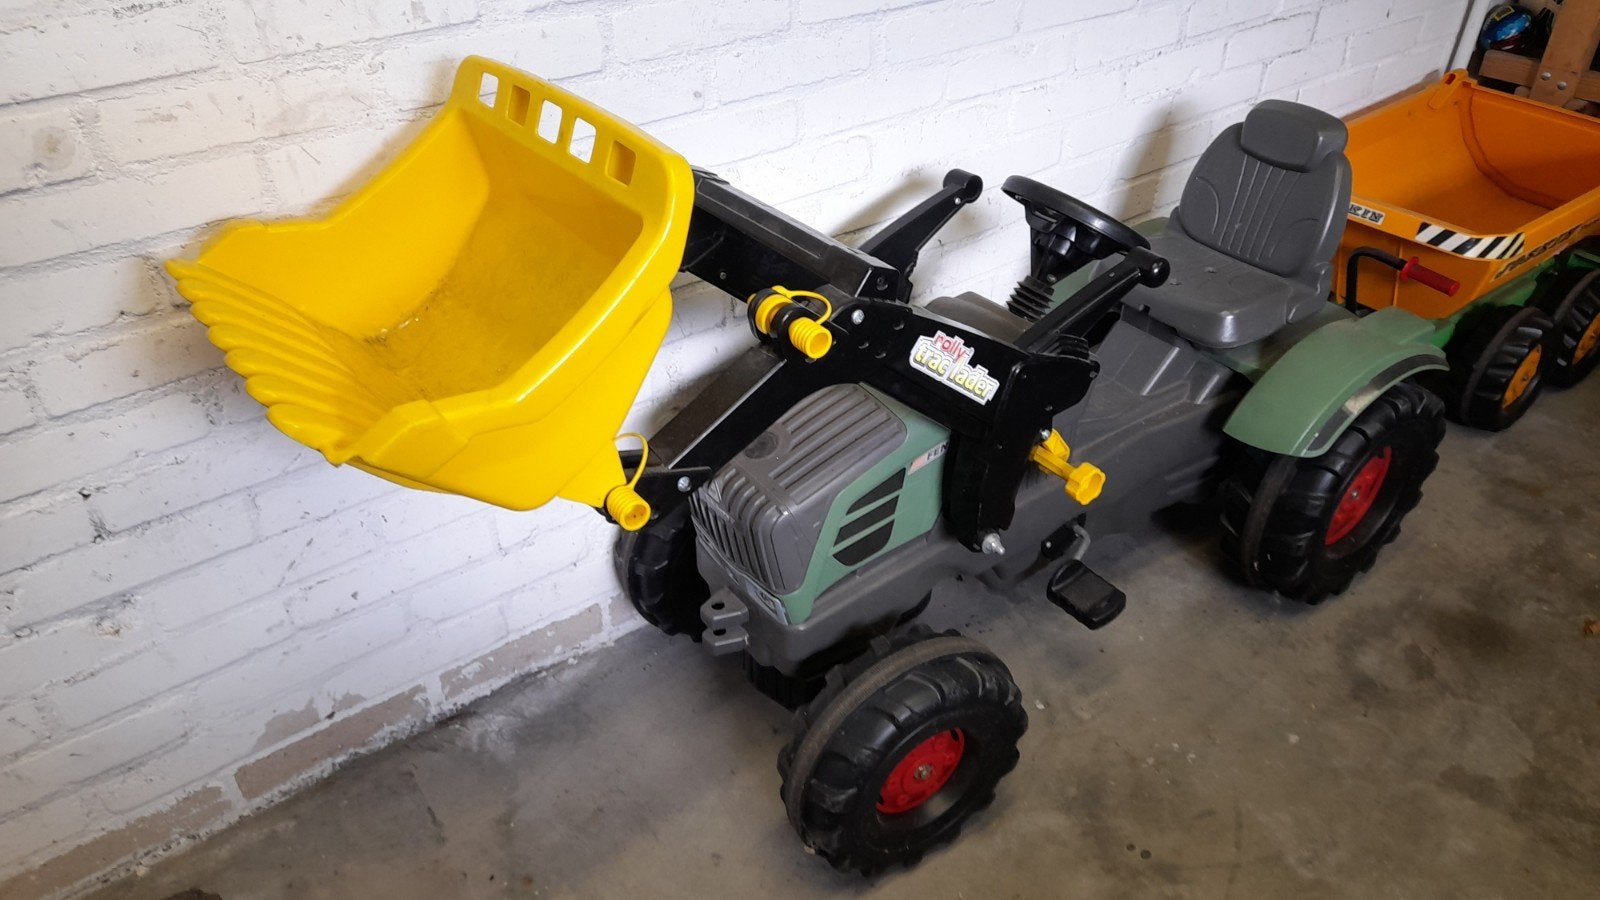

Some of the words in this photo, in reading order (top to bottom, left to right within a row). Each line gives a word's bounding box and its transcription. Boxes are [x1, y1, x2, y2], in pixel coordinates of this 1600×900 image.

[1348, 203, 1384, 223] KIN
[934, 335, 969, 362] rolly
[914, 341, 951, 375] trac
[949, 361, 994, 397] lader
[927, 441, 949, 460] FEN
